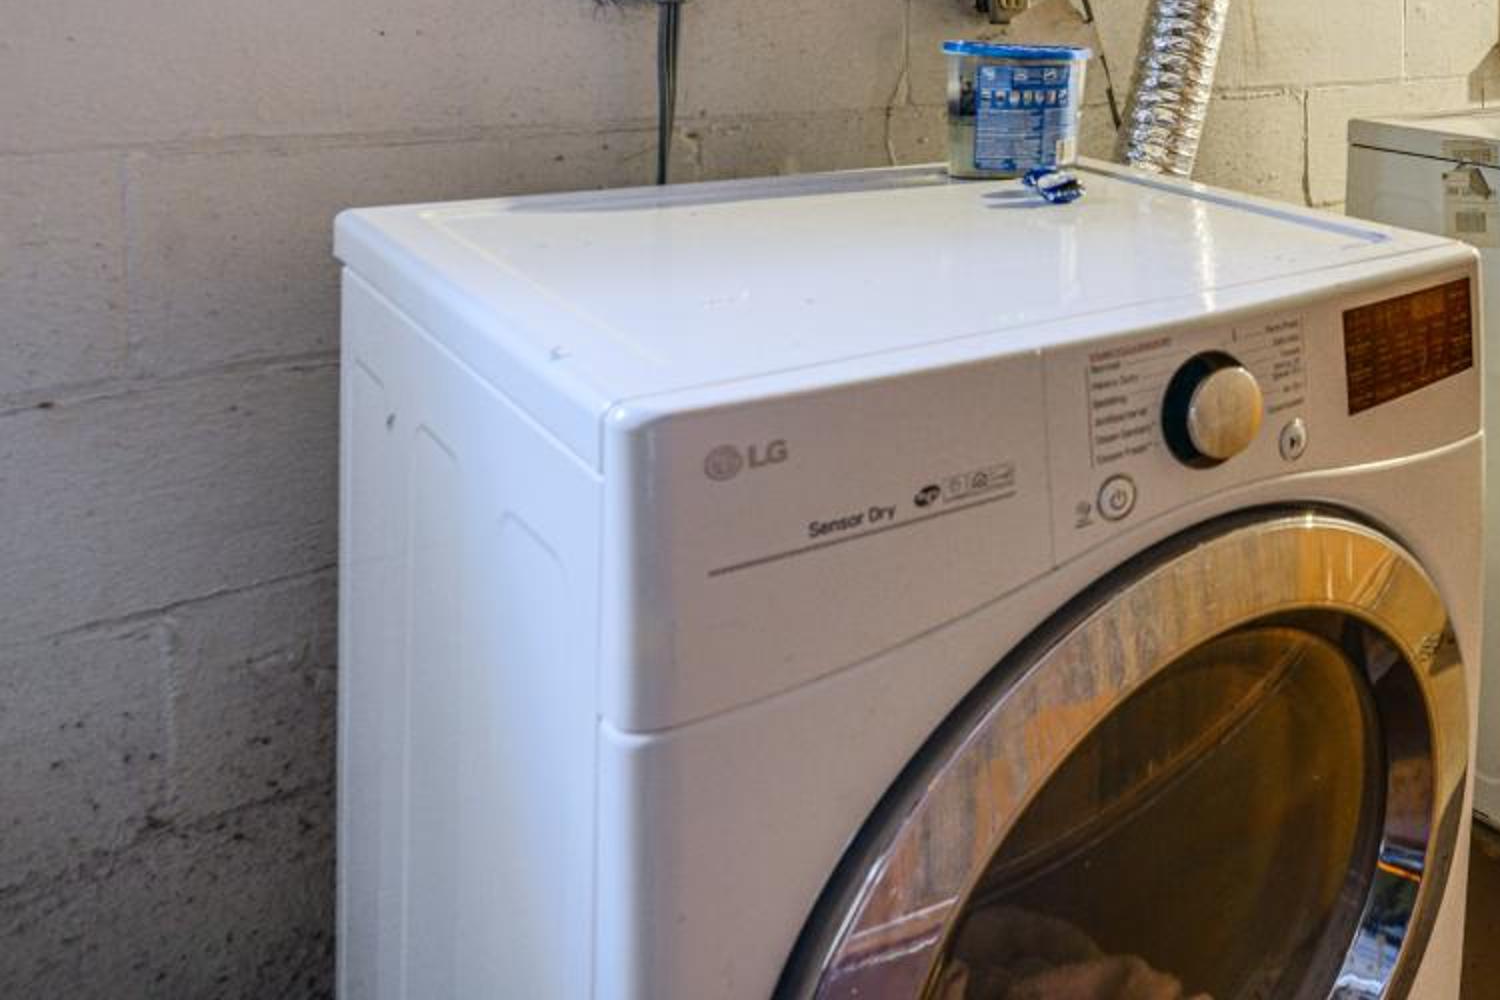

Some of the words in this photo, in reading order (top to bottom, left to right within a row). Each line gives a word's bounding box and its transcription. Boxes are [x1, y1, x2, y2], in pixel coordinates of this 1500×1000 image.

[748, 439, 788, 469] LG
[809, 513, 864, 538] Sensor
[868, 506, 897, 522] Dry
